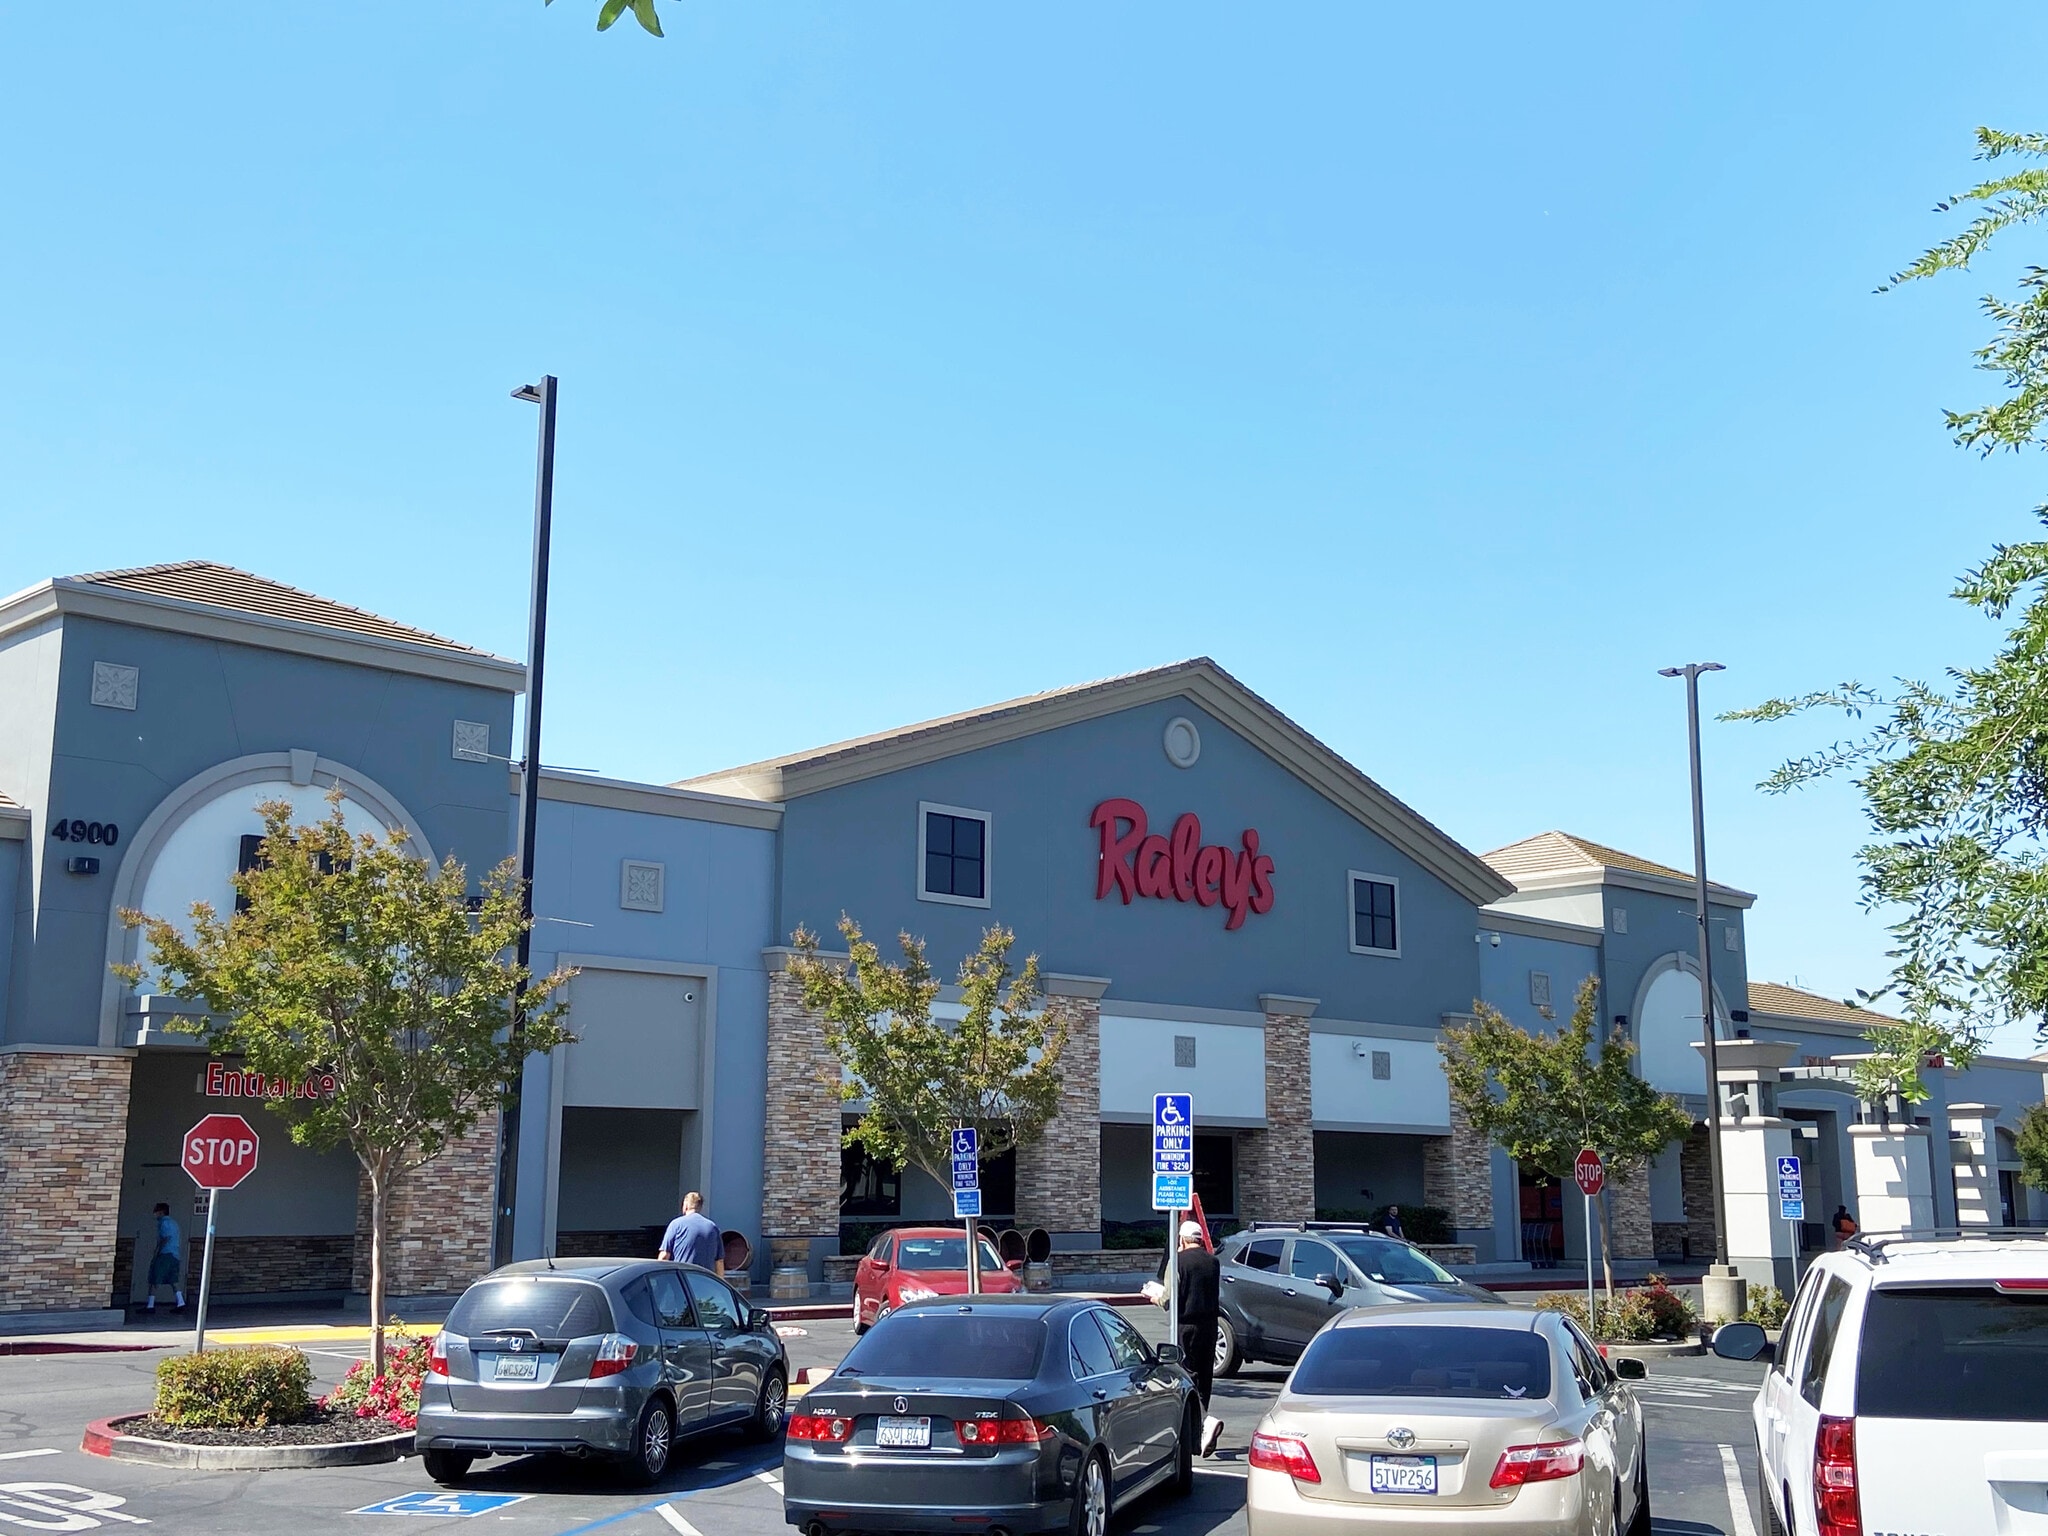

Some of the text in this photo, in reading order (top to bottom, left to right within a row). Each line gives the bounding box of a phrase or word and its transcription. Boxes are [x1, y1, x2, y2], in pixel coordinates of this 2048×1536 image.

[52, 818, 119, 846] 4900
[1090, 797, 1275, 931] Raley's
[1156, 1125, 1190, 1137] PARKING
[1162, 1137, 1184, 1149] ONLY
[188, 1138, 253, 1166] STOP
[1160, 1152, 1186, 1161] MINIMUM
[1156, 1162, 1170, 1170] FINE
[1577, 1164, 1602, 1181] STOP
[1375, 1468, 1432, 1486] 5TVP256
